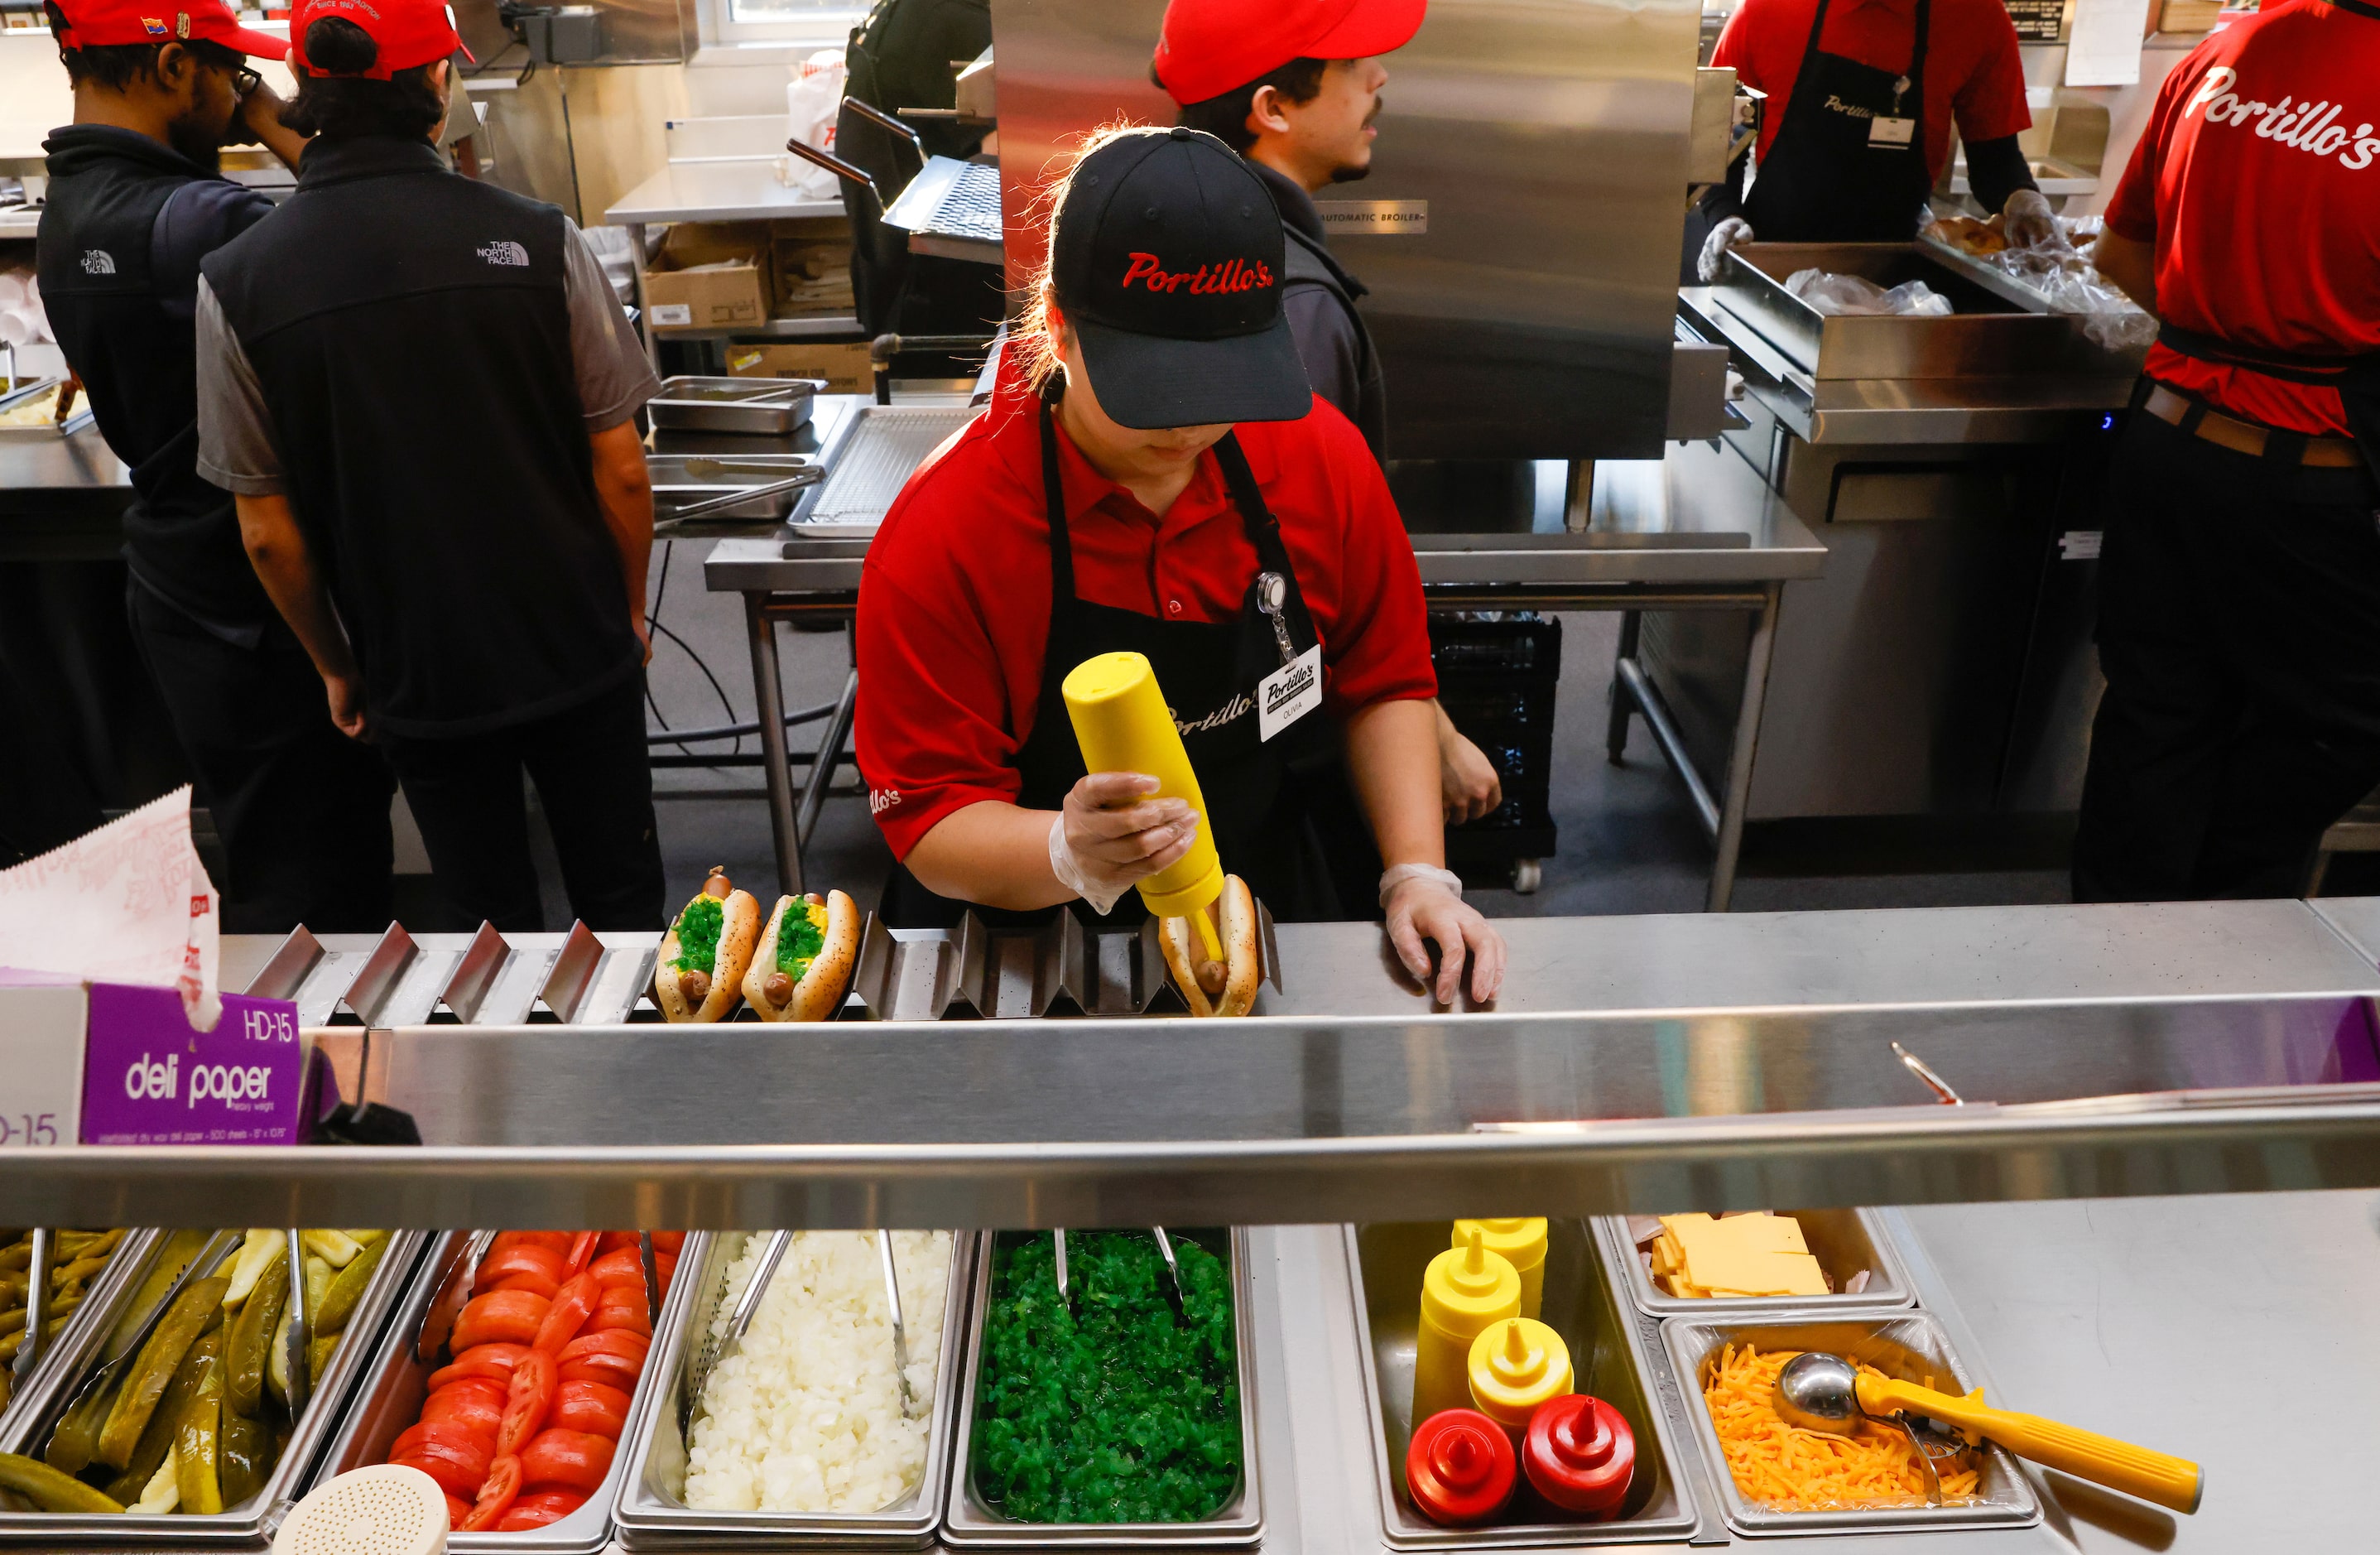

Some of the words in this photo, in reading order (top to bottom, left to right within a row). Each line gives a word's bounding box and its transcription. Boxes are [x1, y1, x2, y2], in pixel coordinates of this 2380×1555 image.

[1824, 94, 1876, 118] Portillo
[2185, 65, 2380, 170] Portillo's
[1321, 214, 1376, 222] AUTOMATIC
[1381, 214, 1420, 222] BROILER
[84, 249, 99, 258] THE
[477, 248, 511, 258] NORTH
[490, 240, 510, 249] THE
[488, 256, 513, 265] FACE
[1123, 252, 1268, 296] Portillo's
[1267, 664, 1313, 704] Portillo's
[1283, 701, 1302, 720] OLIVIA
[243, 1009, 293, 1043] HD-15
[126, 1052, 179, 1100] deli
[188, 1064, 272, 1110] paper
